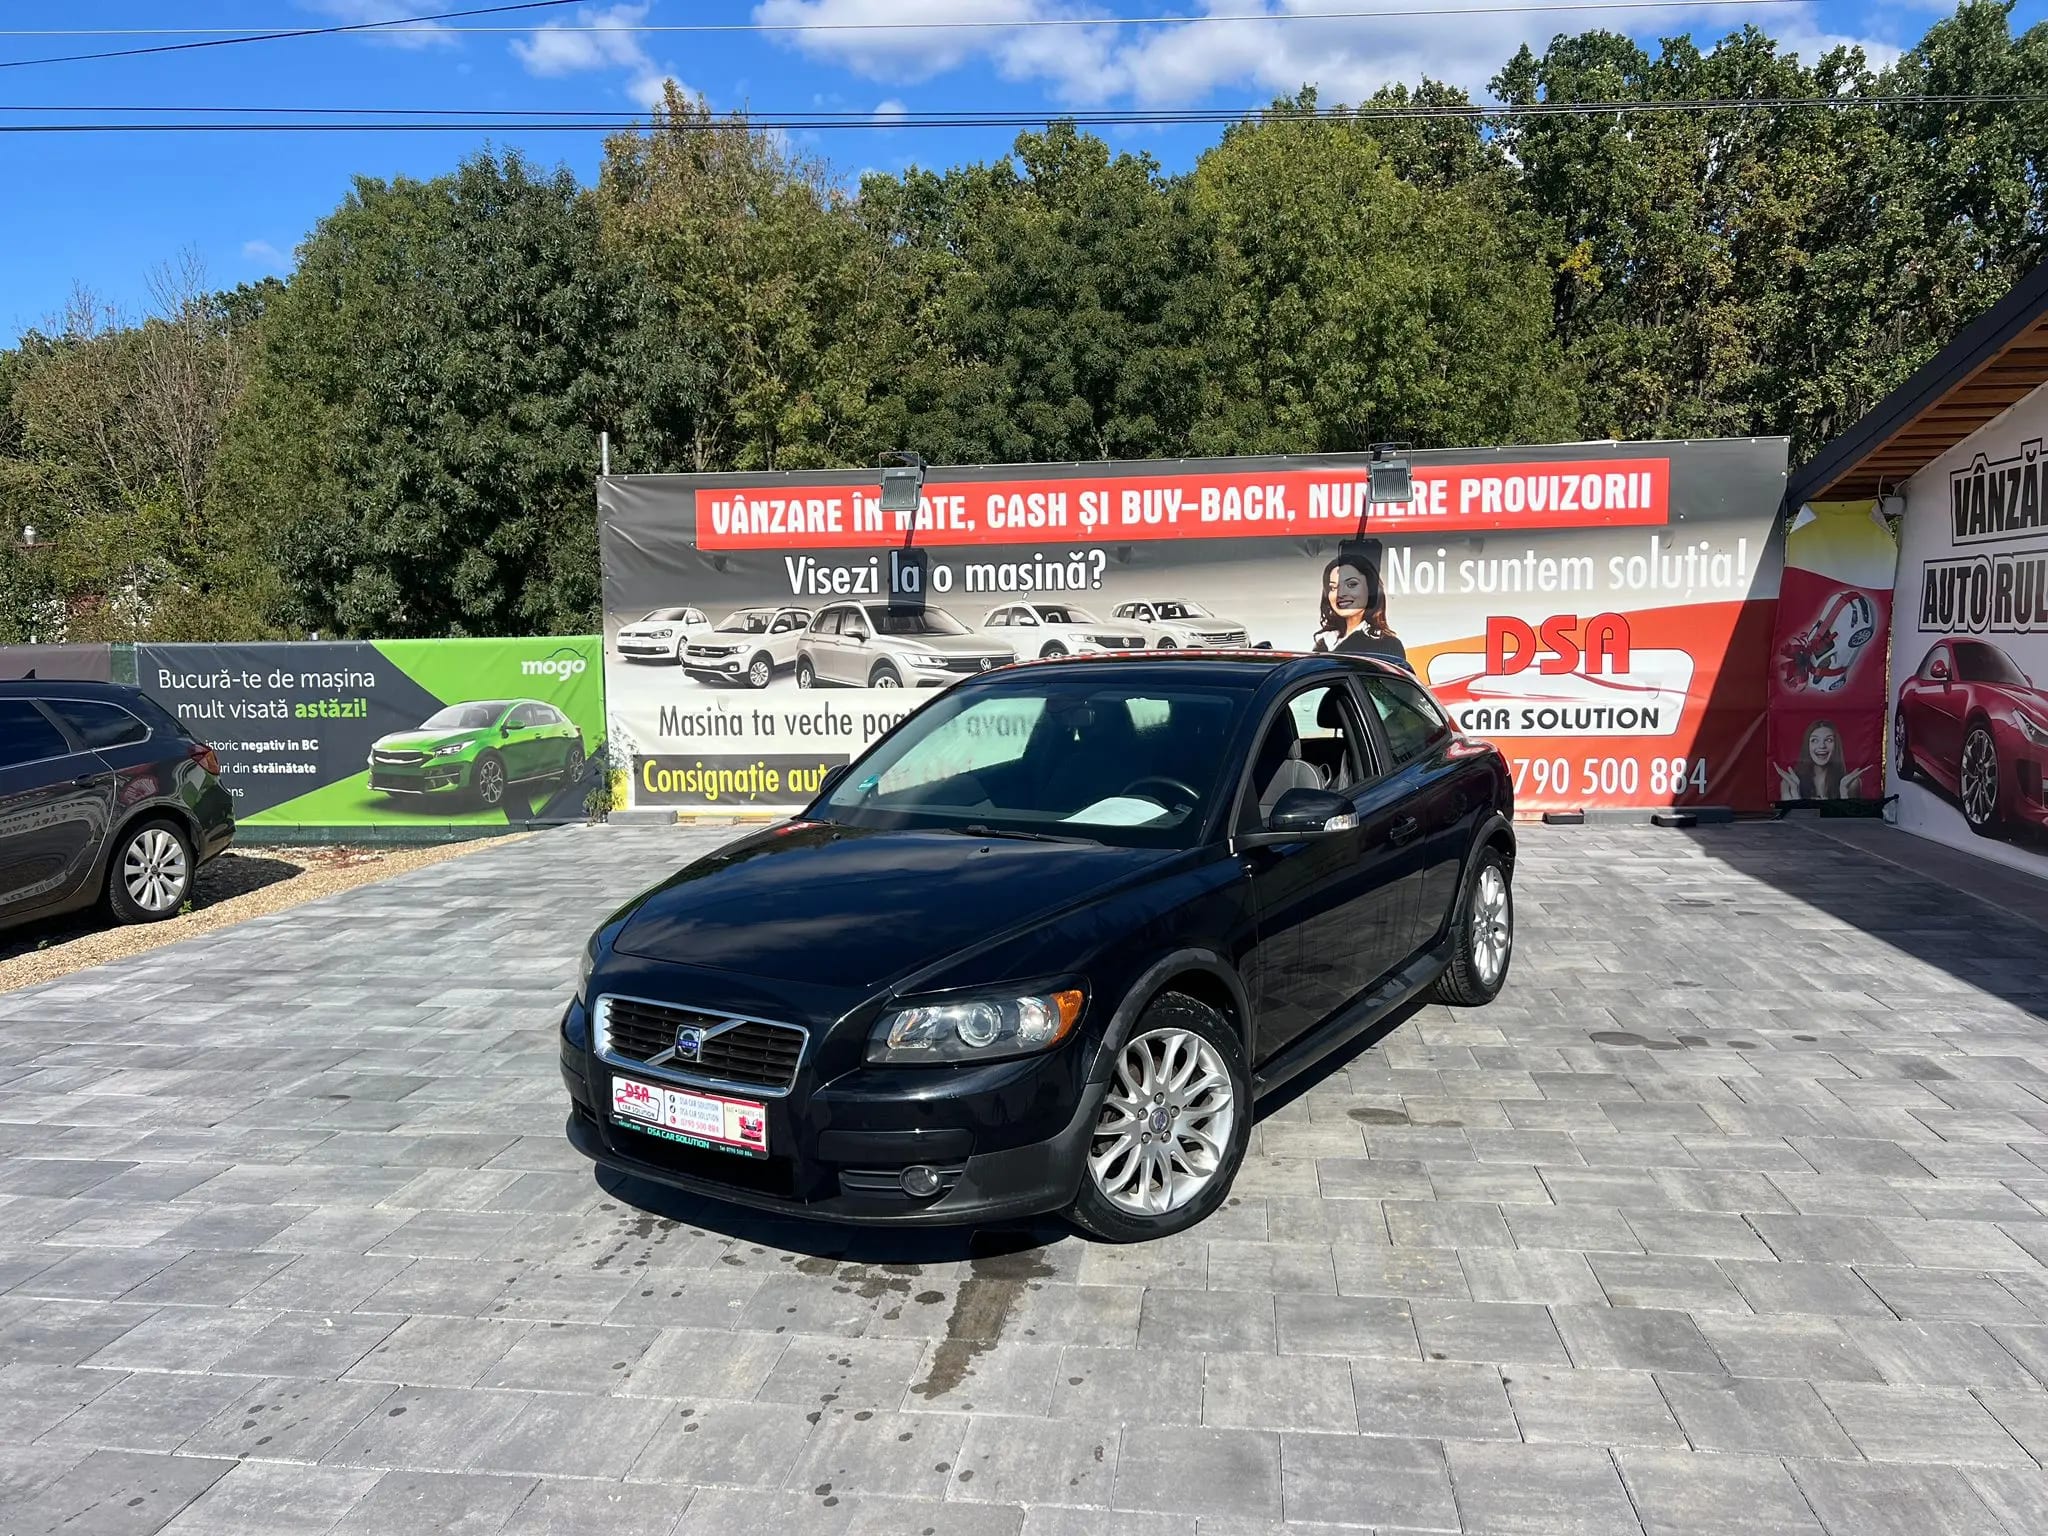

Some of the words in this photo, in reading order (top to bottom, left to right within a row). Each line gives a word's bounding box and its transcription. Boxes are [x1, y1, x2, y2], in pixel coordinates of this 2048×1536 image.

[711, 494, 843, 535] VÂNZARE
[852, 491, 884, 532] ÎN
[986, 491, 1068, 529] CASH
[1078, 489, 1109, 535] ȘI
[1120, 484, 1296, 528] BUY-BACK,
[1459, 472, 1652, 514] PROVIZORII
[784, 555, 880, 595] Visezi
[890, 551, 920, 593] la
[932, 563, 952, 593] o
[964, 548, 1107, 600] mașină?
[1387, 546, 1447, 596] Noi
[1459, 548, 1592, 594] suntem
[1609, 535, 1747, 600] soluția!
[1922, 563, 1988, 625] AUTO
[1485, 612, 1631, 676] DSA
[158, 668, 262, 690] Bucură-te
[268, 668, 295, 689] de
[301, 668, 376, 692] mașina
[521, 659, 587, 682] mogo
[177, 698, 225, 719] mult
[229, 699, 290, 719] visată
[294, 697, 368, 719] astăzi!
[751, 708, 776, 736] ta
[786, 701, 853, 736] veche
[1459, 707, 1511, 731] CAR
[1520, 707, 1660, 730] SOLUTION
[241, 739, 285, 754] negativ
[302, 739, 319, 751] BC
[232, 762, 250, 774] din
[252, 762, 317, 774] străinătate
[642, 758, 781, 801] Consignație
[1581, 757, 1640, 796] 500
[1649, 756, 1708, 796] 884
[625, 1082, 649, 1103] DSA
[647, 1126, 661, 1138] DSA
[661, 1130, 675, 1142] CAR
[675, 1135, 710, 1150] SOLUTION
